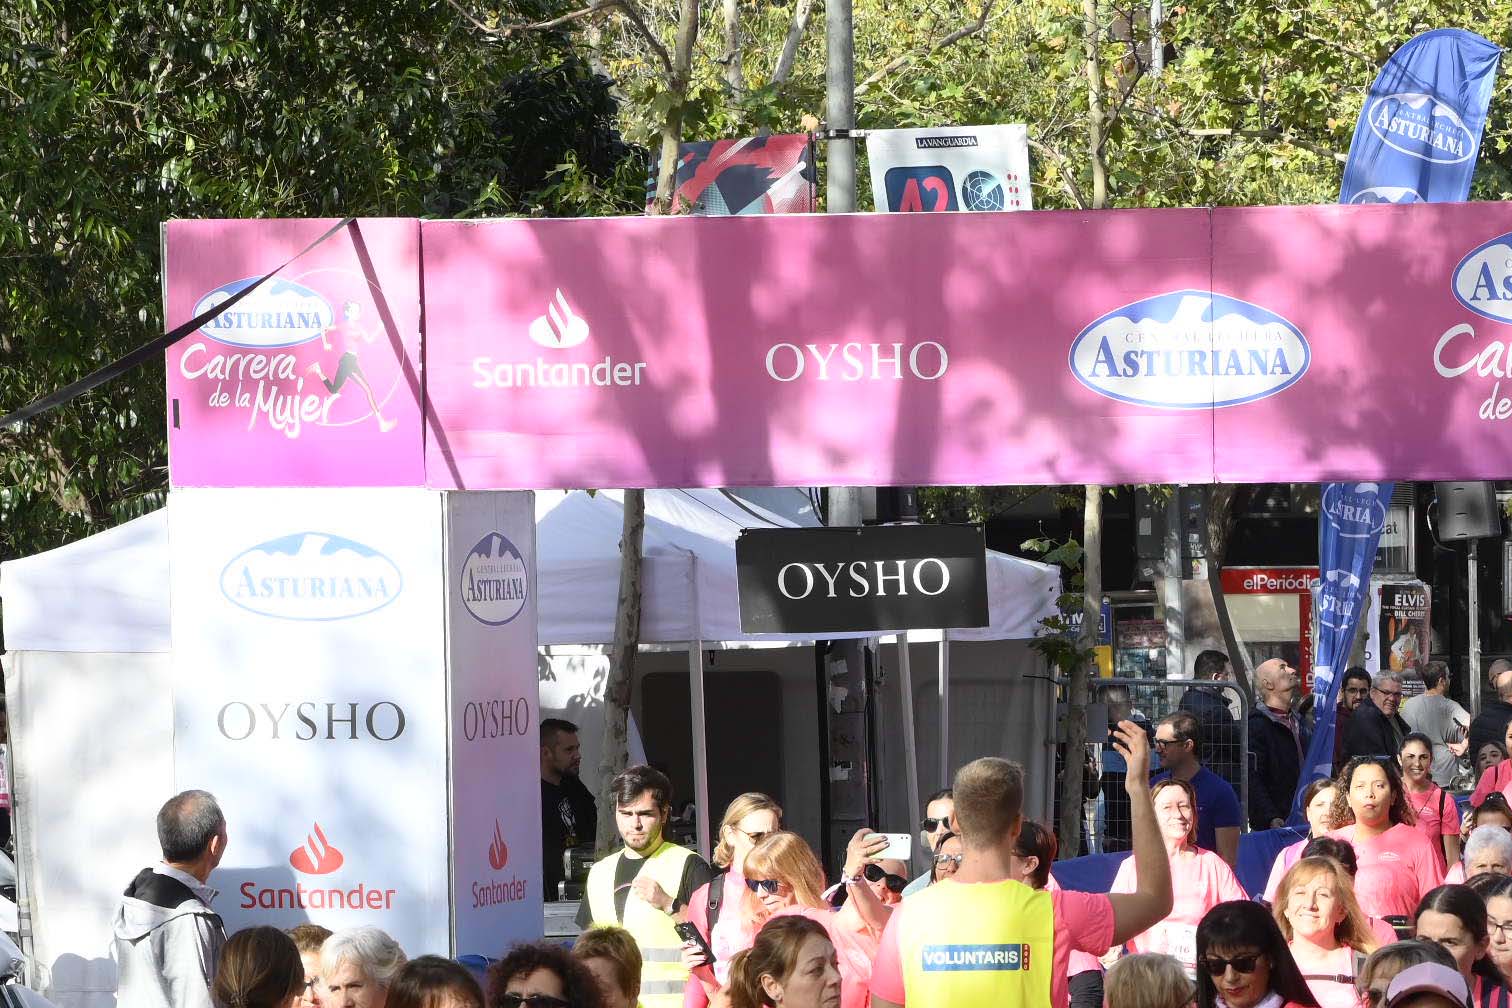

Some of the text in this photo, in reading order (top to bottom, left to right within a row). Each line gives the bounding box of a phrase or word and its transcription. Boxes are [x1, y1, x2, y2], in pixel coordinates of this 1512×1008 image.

[927, 136, 976, 147] VANGUARDIA
[180, 343, 297, 380] Carrera
[473, 355, 647, 390] Santander
[765, 340, 949, 382] OYSHO
[1088, 335, 1292, 378] ASTURIANA
[208, 377, 342, 439] de la Mujer
[237, 565, 389, 598] ASTURIANA
[467, 568, 524, 602] ASTURIANA
[777, 557, 951, 601] OYSHO
[1395, 594, 1425, 606] ELVIS
[217, 701, 406, 741] OYSHO
[463, 697, 530, 742] OYSHO
[240, 882, 396, 909] Santander
[472, 875, 527, 909] Santander
[923, 949, 1019, 966] VOLUNTARIS
